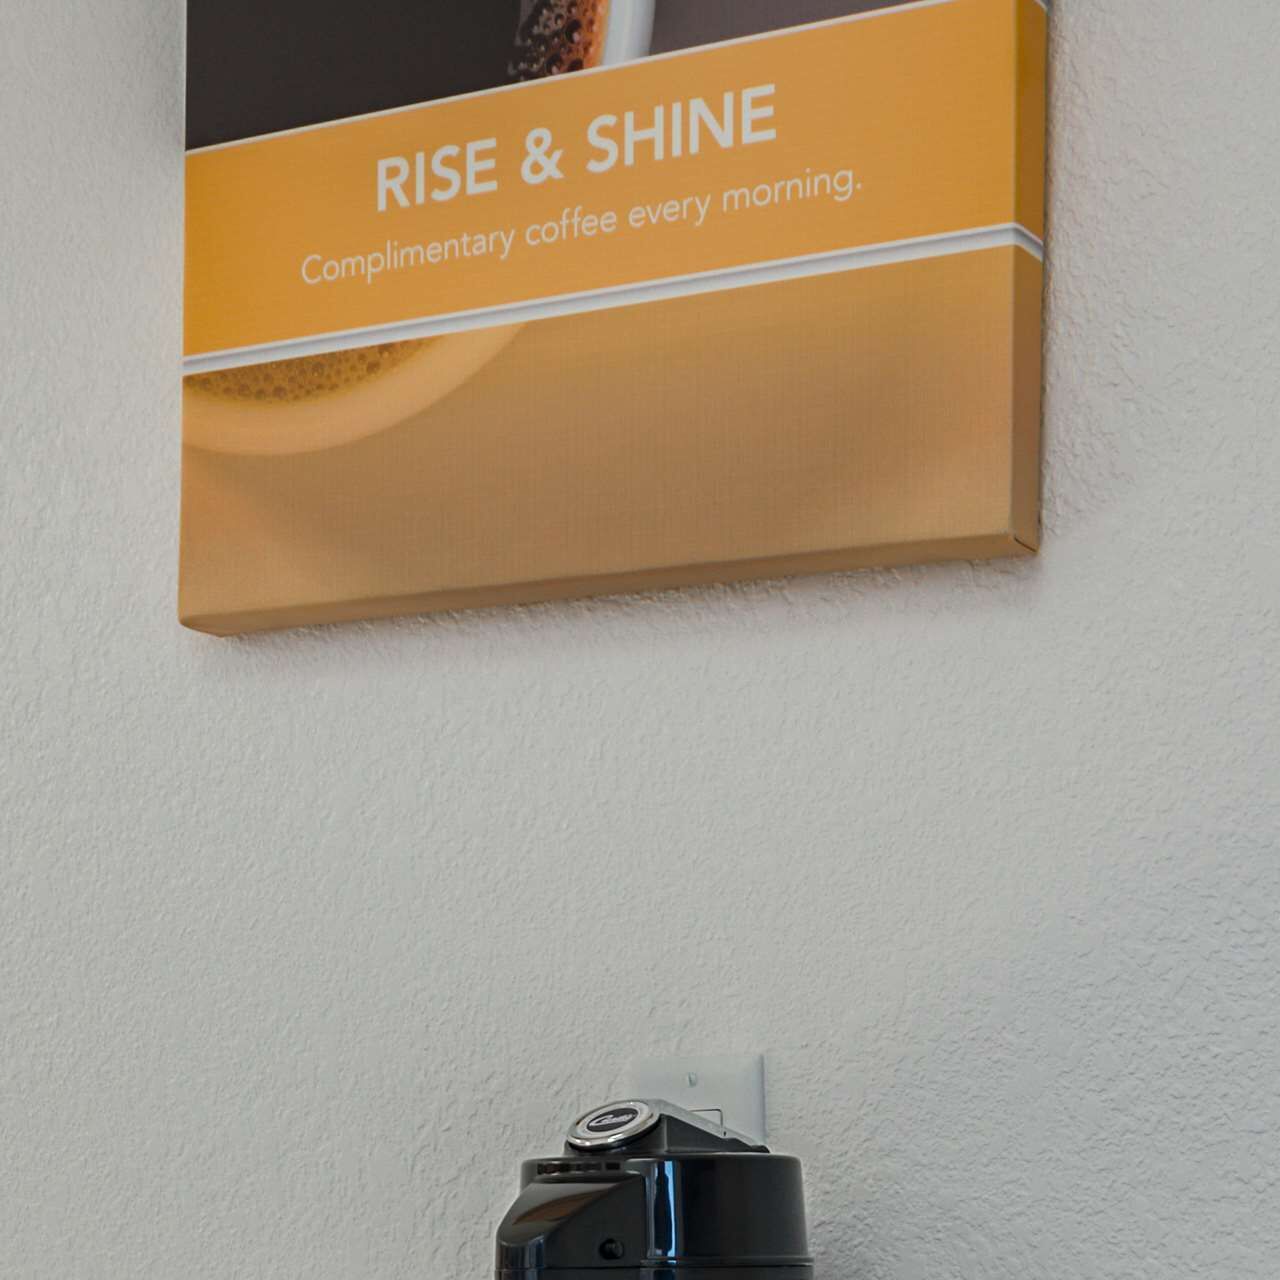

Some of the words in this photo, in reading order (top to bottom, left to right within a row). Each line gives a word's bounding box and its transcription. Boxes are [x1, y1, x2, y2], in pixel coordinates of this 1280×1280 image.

[376, 136, 499, 212] RISE
[520, 126, 565, 185] &
[585, 83, 777, 174] SHINE
[301, 226, 515, 284] Complimentary
[525, 205, 618, 248] coffee
[627, 193, 711, 229] every
[722, 167, 863, 212] morning.
